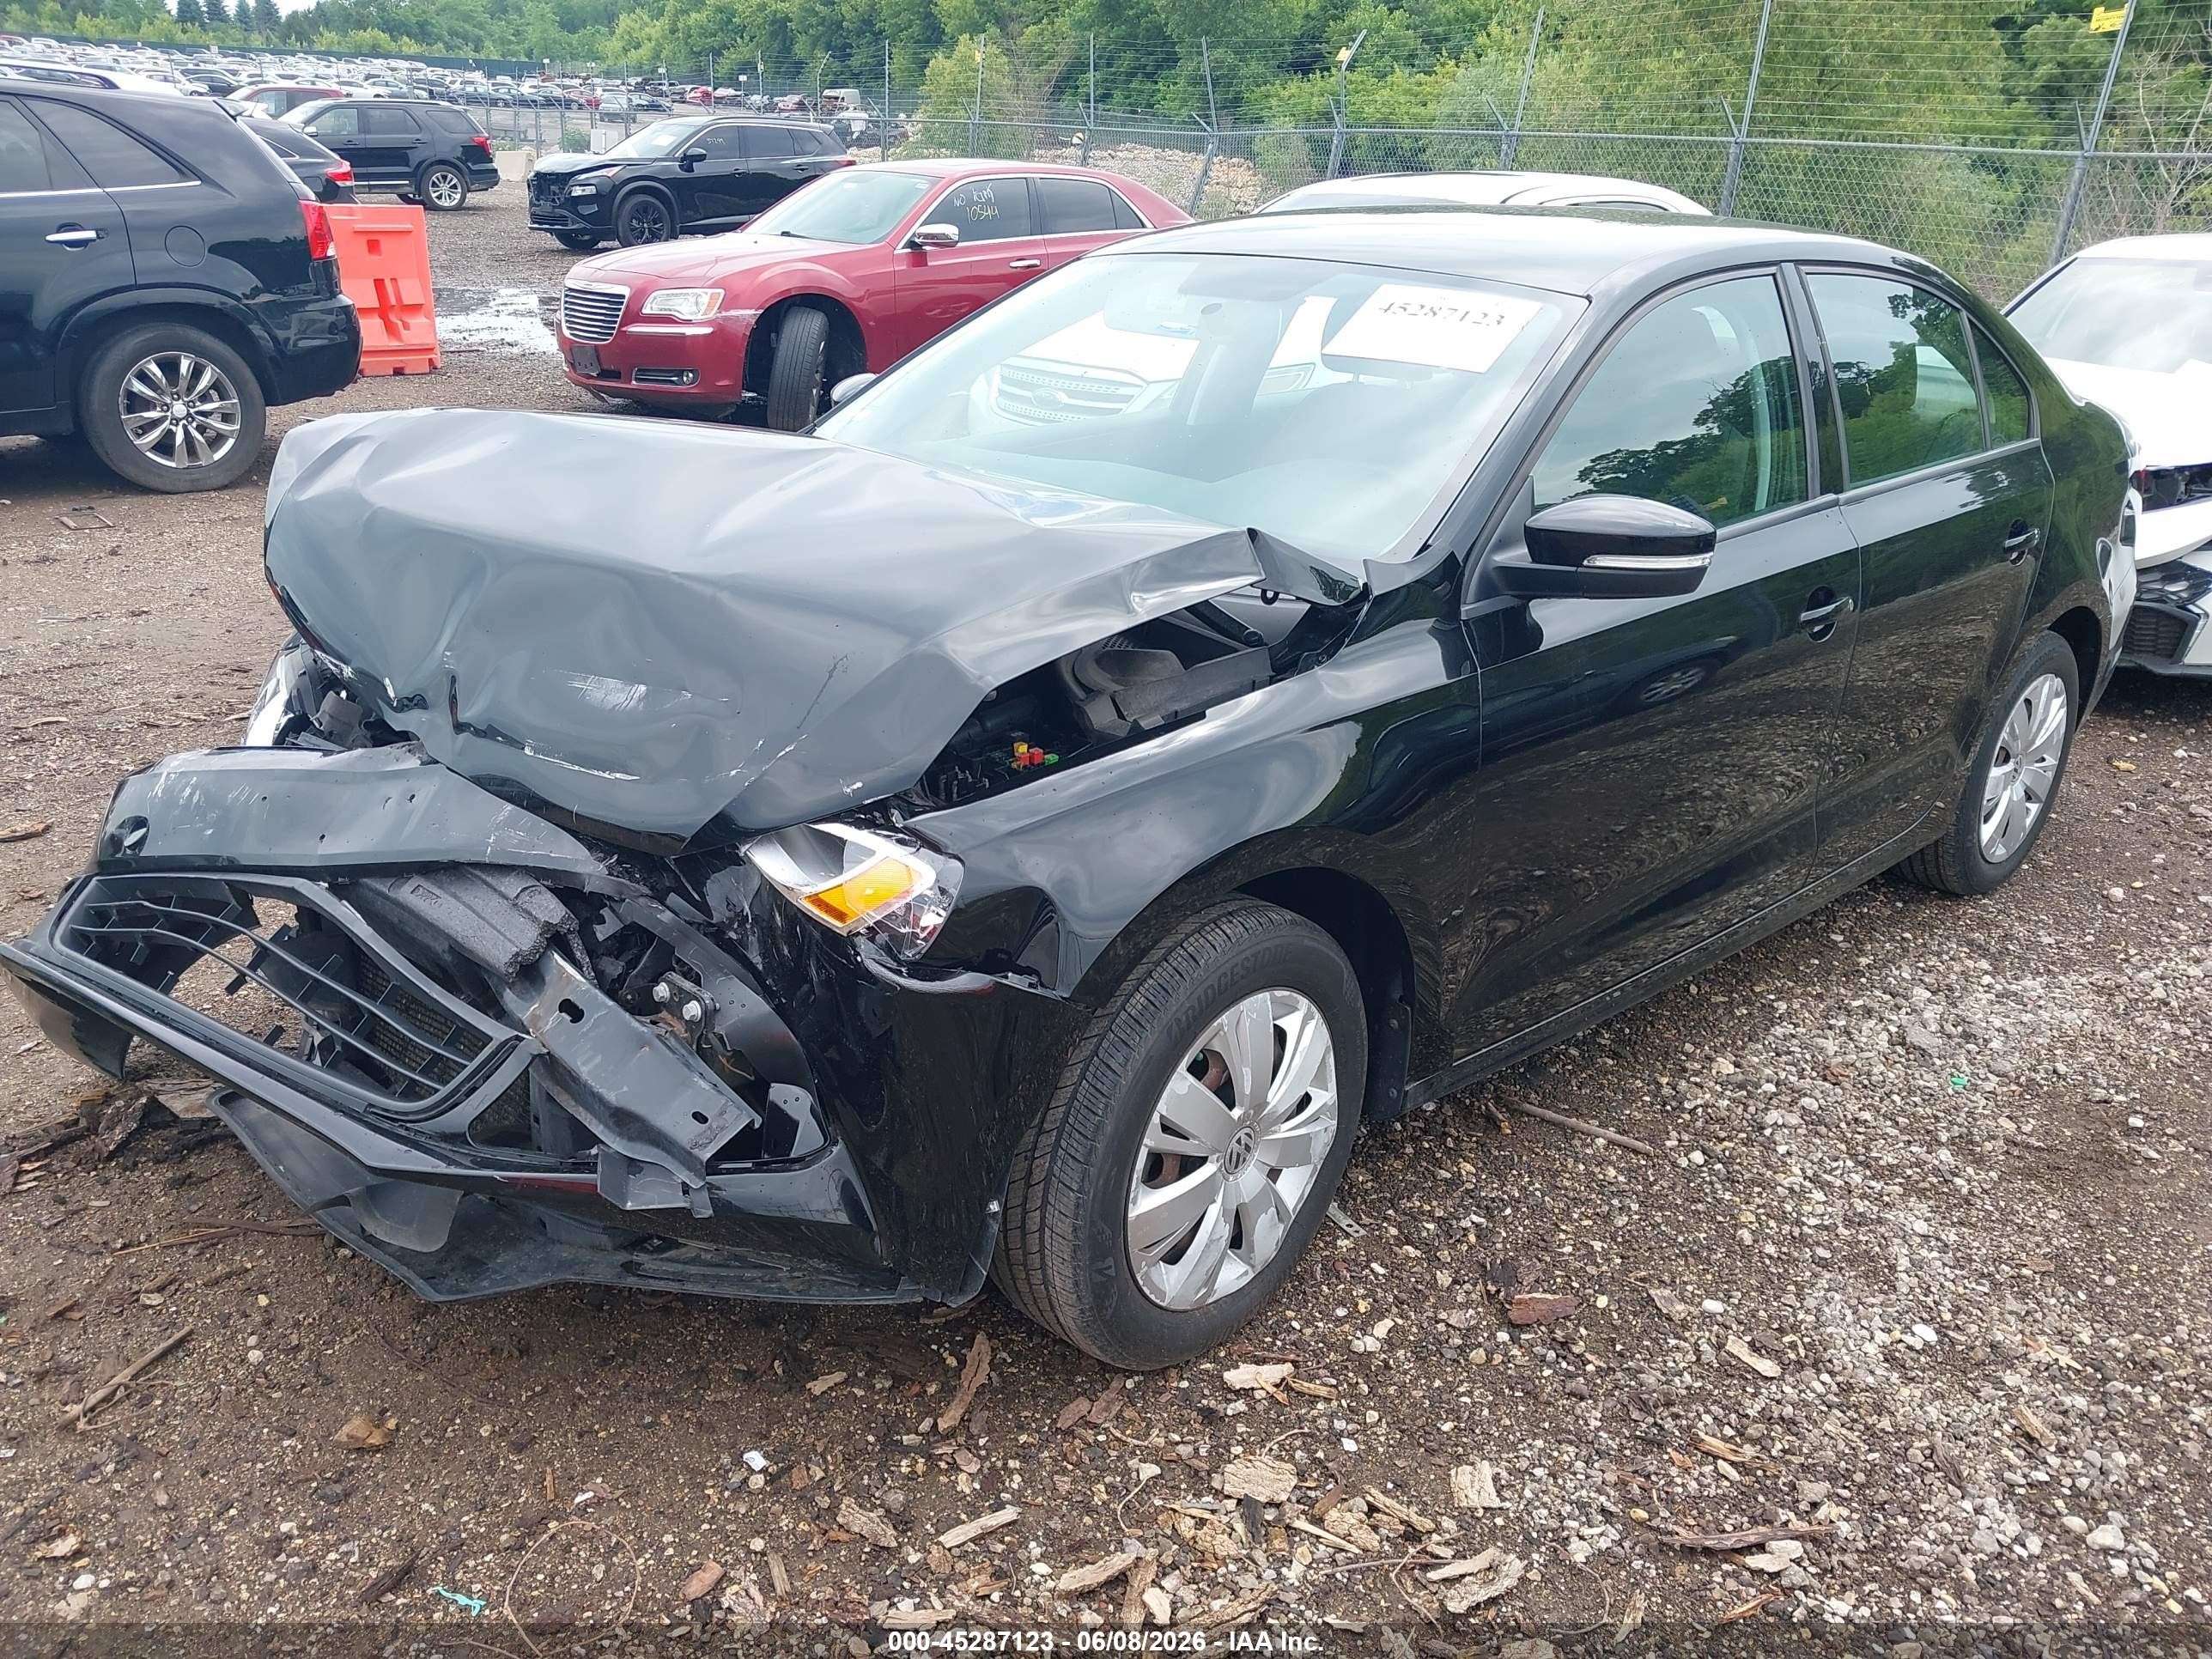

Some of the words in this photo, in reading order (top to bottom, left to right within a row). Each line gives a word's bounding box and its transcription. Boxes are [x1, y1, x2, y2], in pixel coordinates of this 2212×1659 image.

[953, 193, 966, 207] NO
[966, 204, 1000, 224] 10544
[1378, 301, 1505, 325] 45287123
